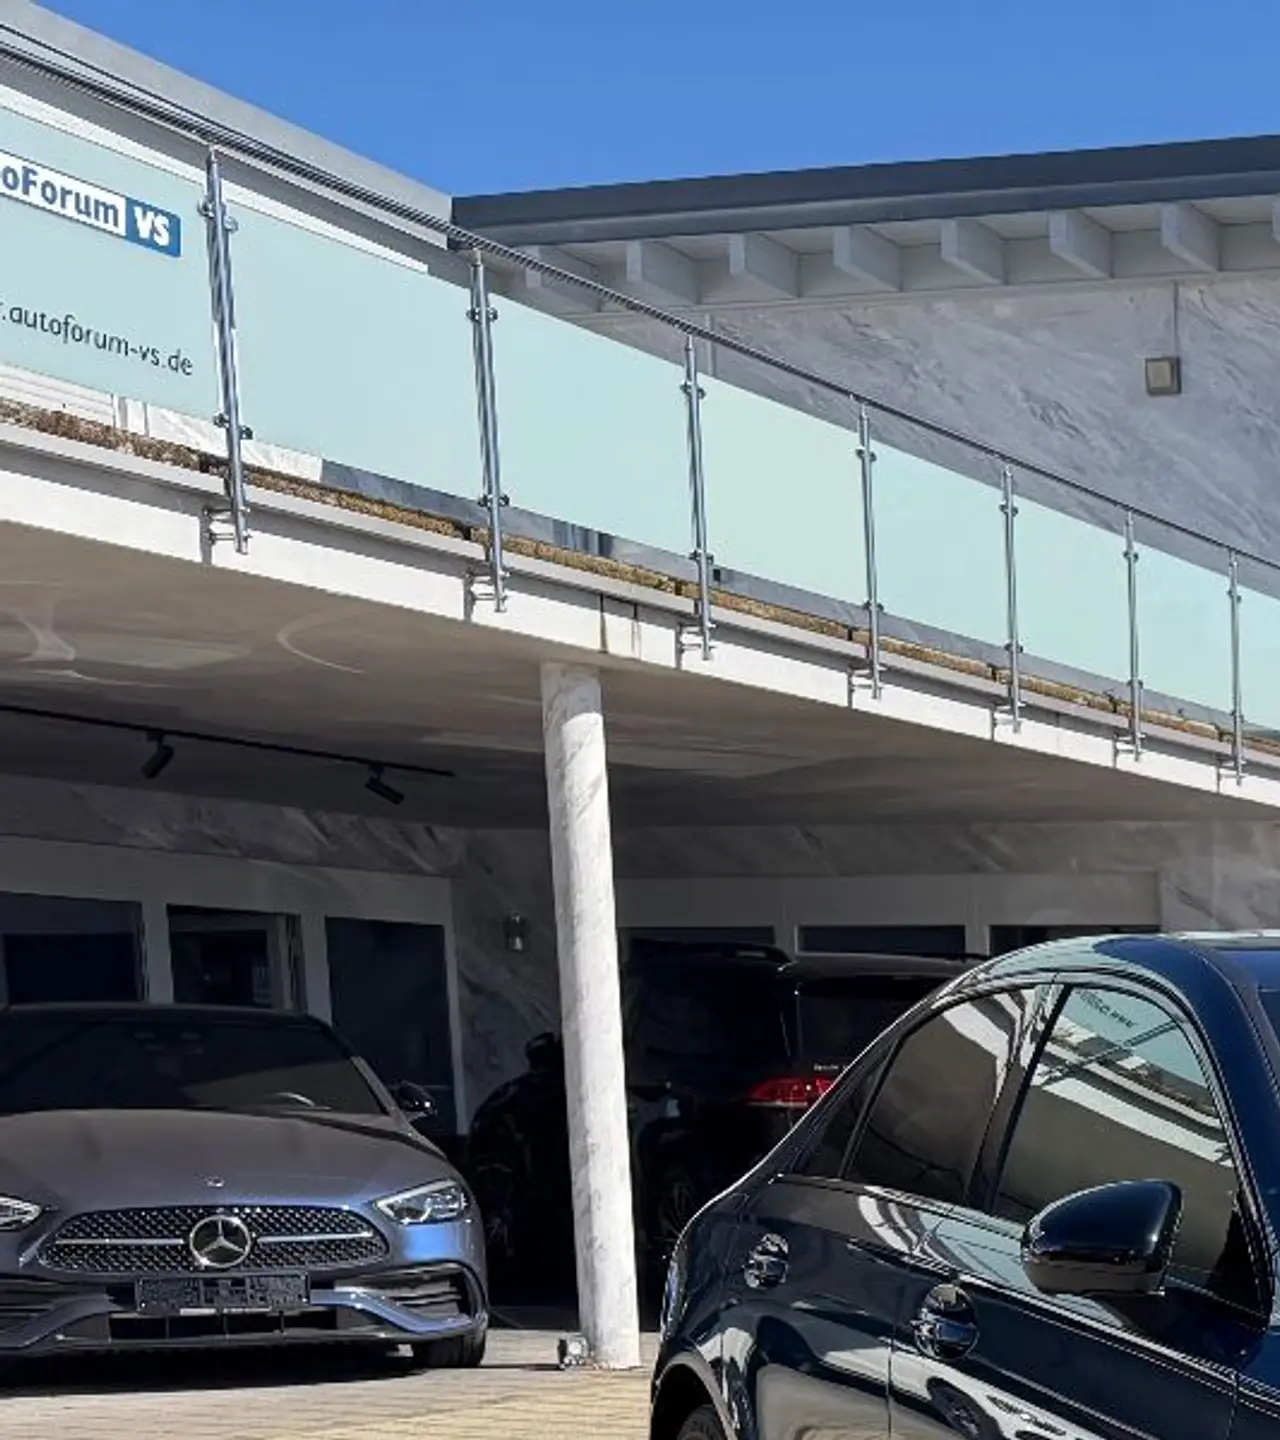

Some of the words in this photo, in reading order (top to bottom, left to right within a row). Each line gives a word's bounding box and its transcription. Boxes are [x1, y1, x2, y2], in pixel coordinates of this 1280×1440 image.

[0, 165, 120, 229] oForum
[134, 206, 170, 247] VS
[0, 301, 193, 375] .autoforum-vs.de
